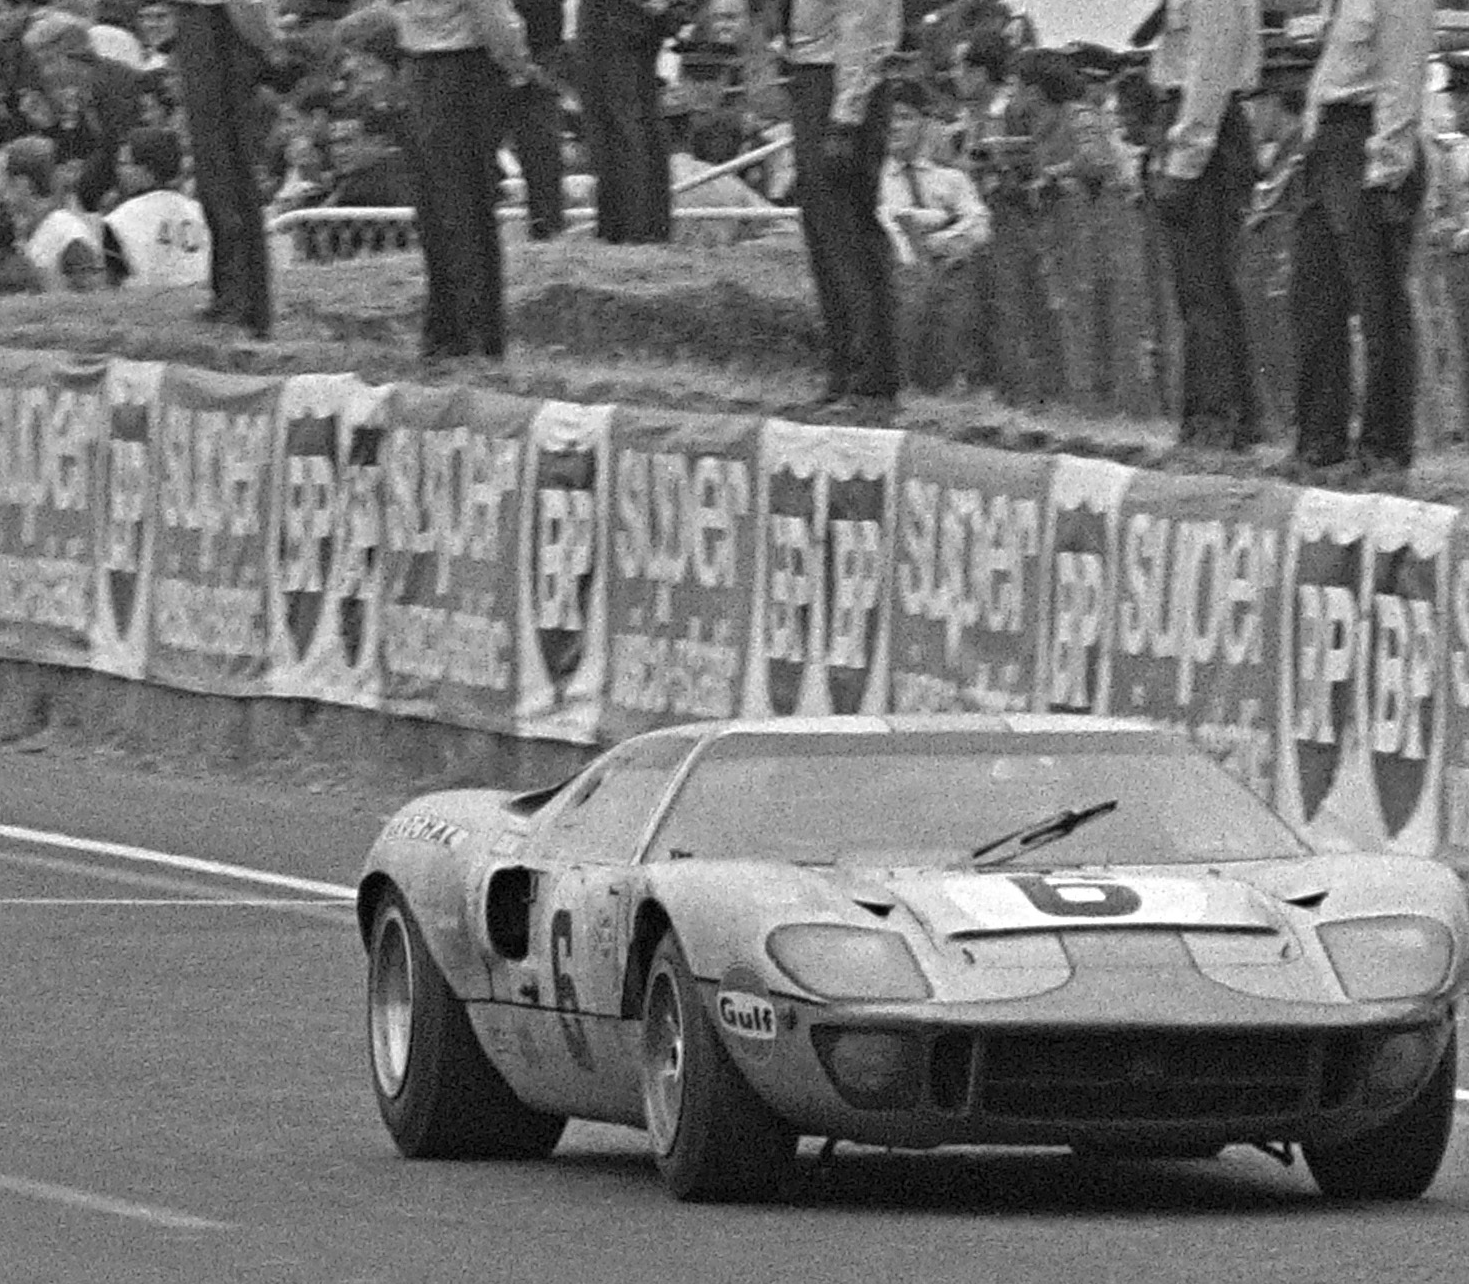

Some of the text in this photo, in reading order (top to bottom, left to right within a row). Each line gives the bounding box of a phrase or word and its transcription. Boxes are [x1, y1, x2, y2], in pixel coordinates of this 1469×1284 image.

[538, 488, 596, 631] BP
[1119, 513, 1278, 707] super
[1006, 871, 1143, 918] 6
[550, 908, 595, 1071] 6
[718, 994, 773, 1033] Gulf
